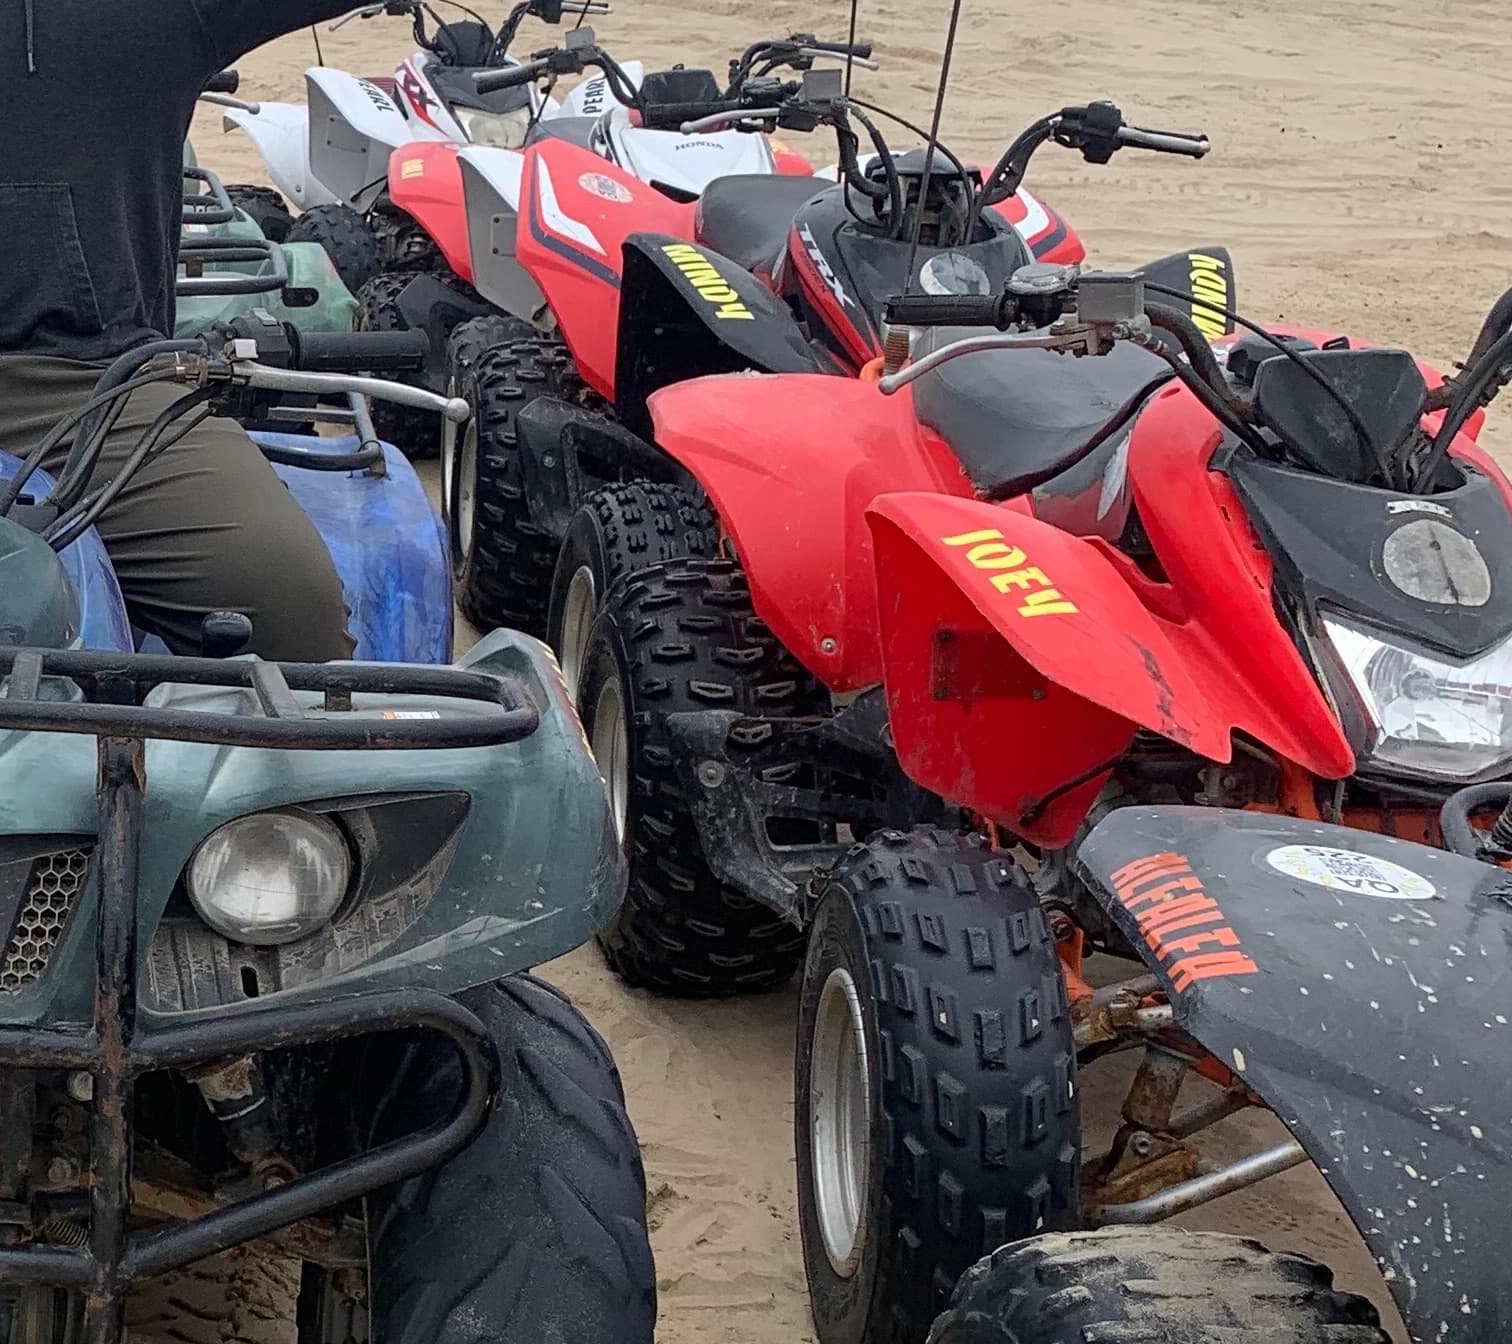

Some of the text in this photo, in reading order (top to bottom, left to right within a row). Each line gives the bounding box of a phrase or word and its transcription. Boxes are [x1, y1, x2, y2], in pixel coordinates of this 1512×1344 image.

[661, 244, 756, 320] MINDY
[799, 222, 857, 307] TRX
[1188, 253, 1227, 343] MINDY
[940, 528, 1081, 618] JOEY
[1110, 852, 1259, 994] ALFALFA
